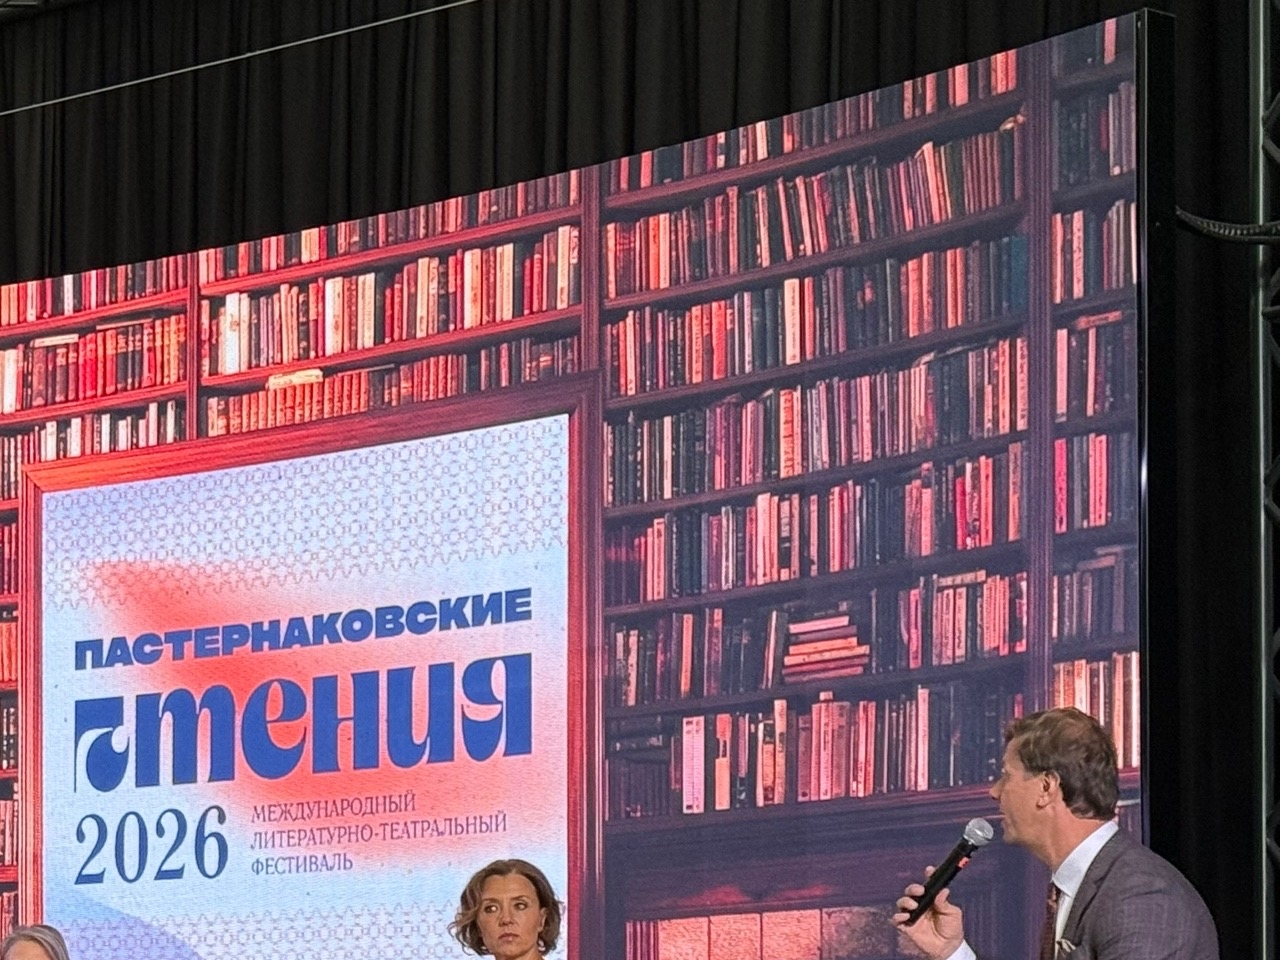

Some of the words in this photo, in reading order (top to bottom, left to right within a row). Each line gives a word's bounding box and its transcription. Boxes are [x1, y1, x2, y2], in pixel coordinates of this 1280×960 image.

[74, 587, 532, 670] ПАСТЕРНАКОВСКИЕ
[251, 789, 416, 823] МЕЖДУНАРОДНЫЙ
[74, 805, 228, 885] 2026
[250, 810, 507, 850] ЛИТЕРАТУРНО-ТЕАТРАЛЬНЫЙ
[251, 853, 353, 875] ФЕСТИВАЛЬ
